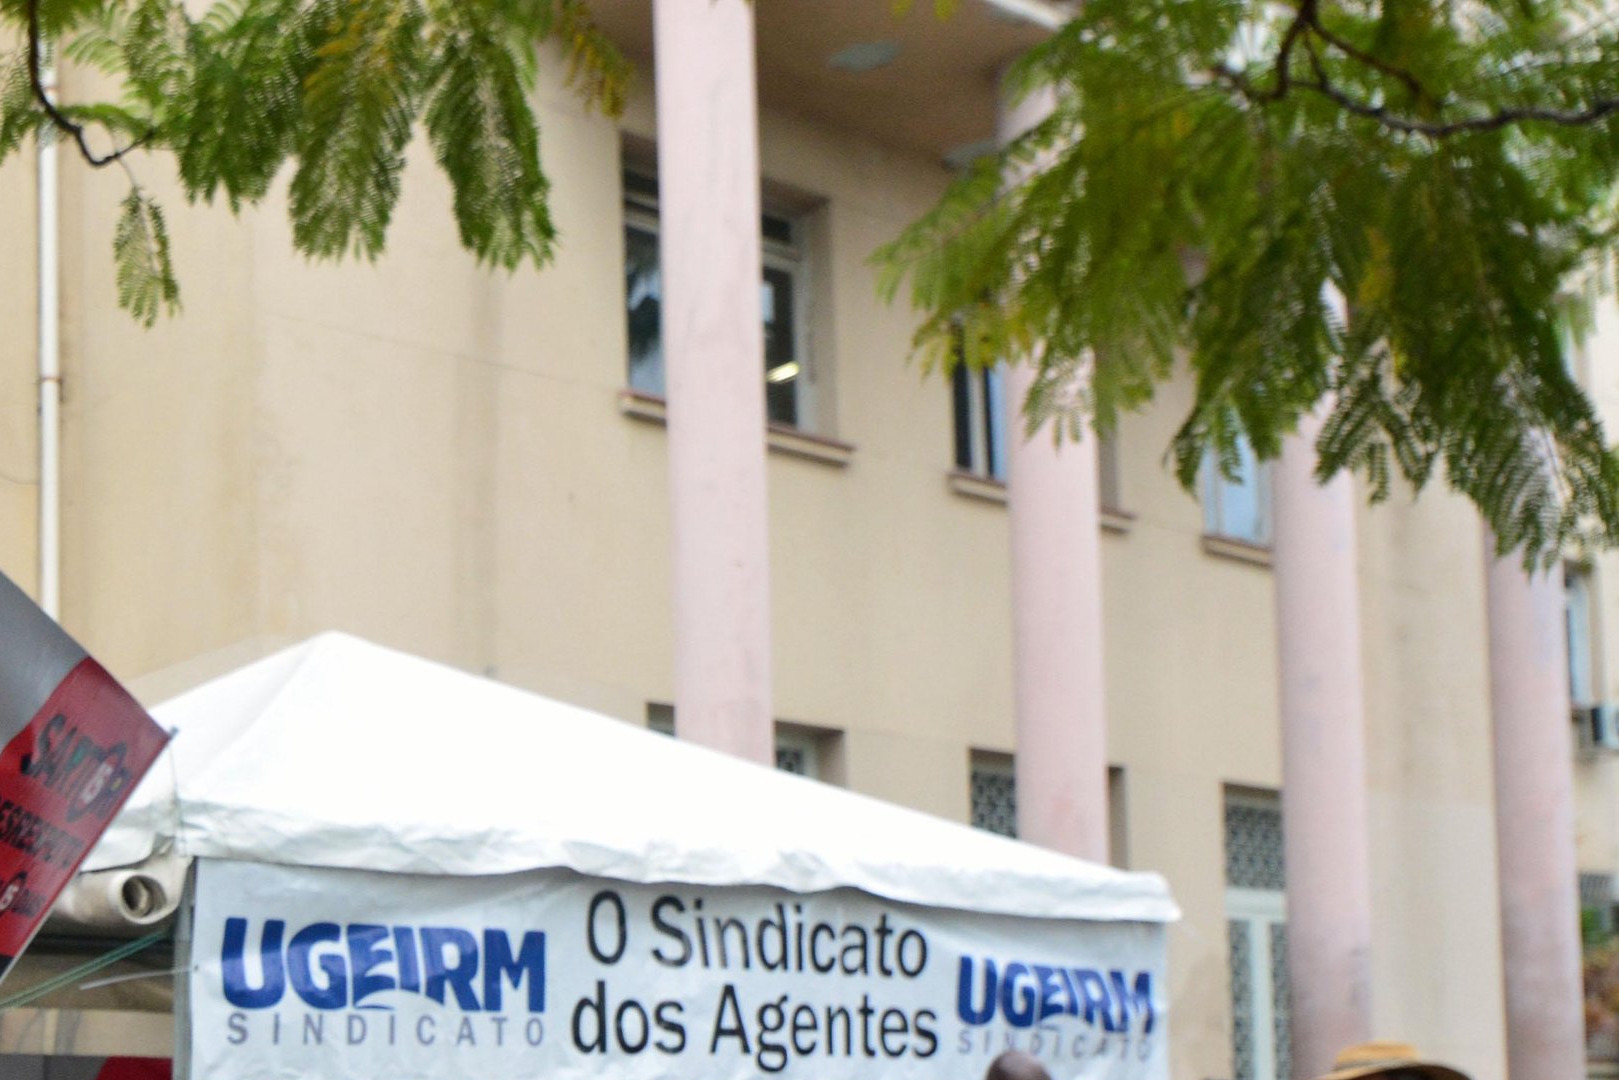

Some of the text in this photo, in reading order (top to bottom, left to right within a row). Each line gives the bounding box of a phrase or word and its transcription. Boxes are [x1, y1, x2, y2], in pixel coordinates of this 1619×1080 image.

[221, 917, 546, 1013] UGEIRM
[587, 890, 928, 978] O Sindicato
[226, 1012, 546, 1046] SINDICATO
[571, 980, 939, 1073] dos Agentes
[956, 956, 1155, 1034] UGEIRM
